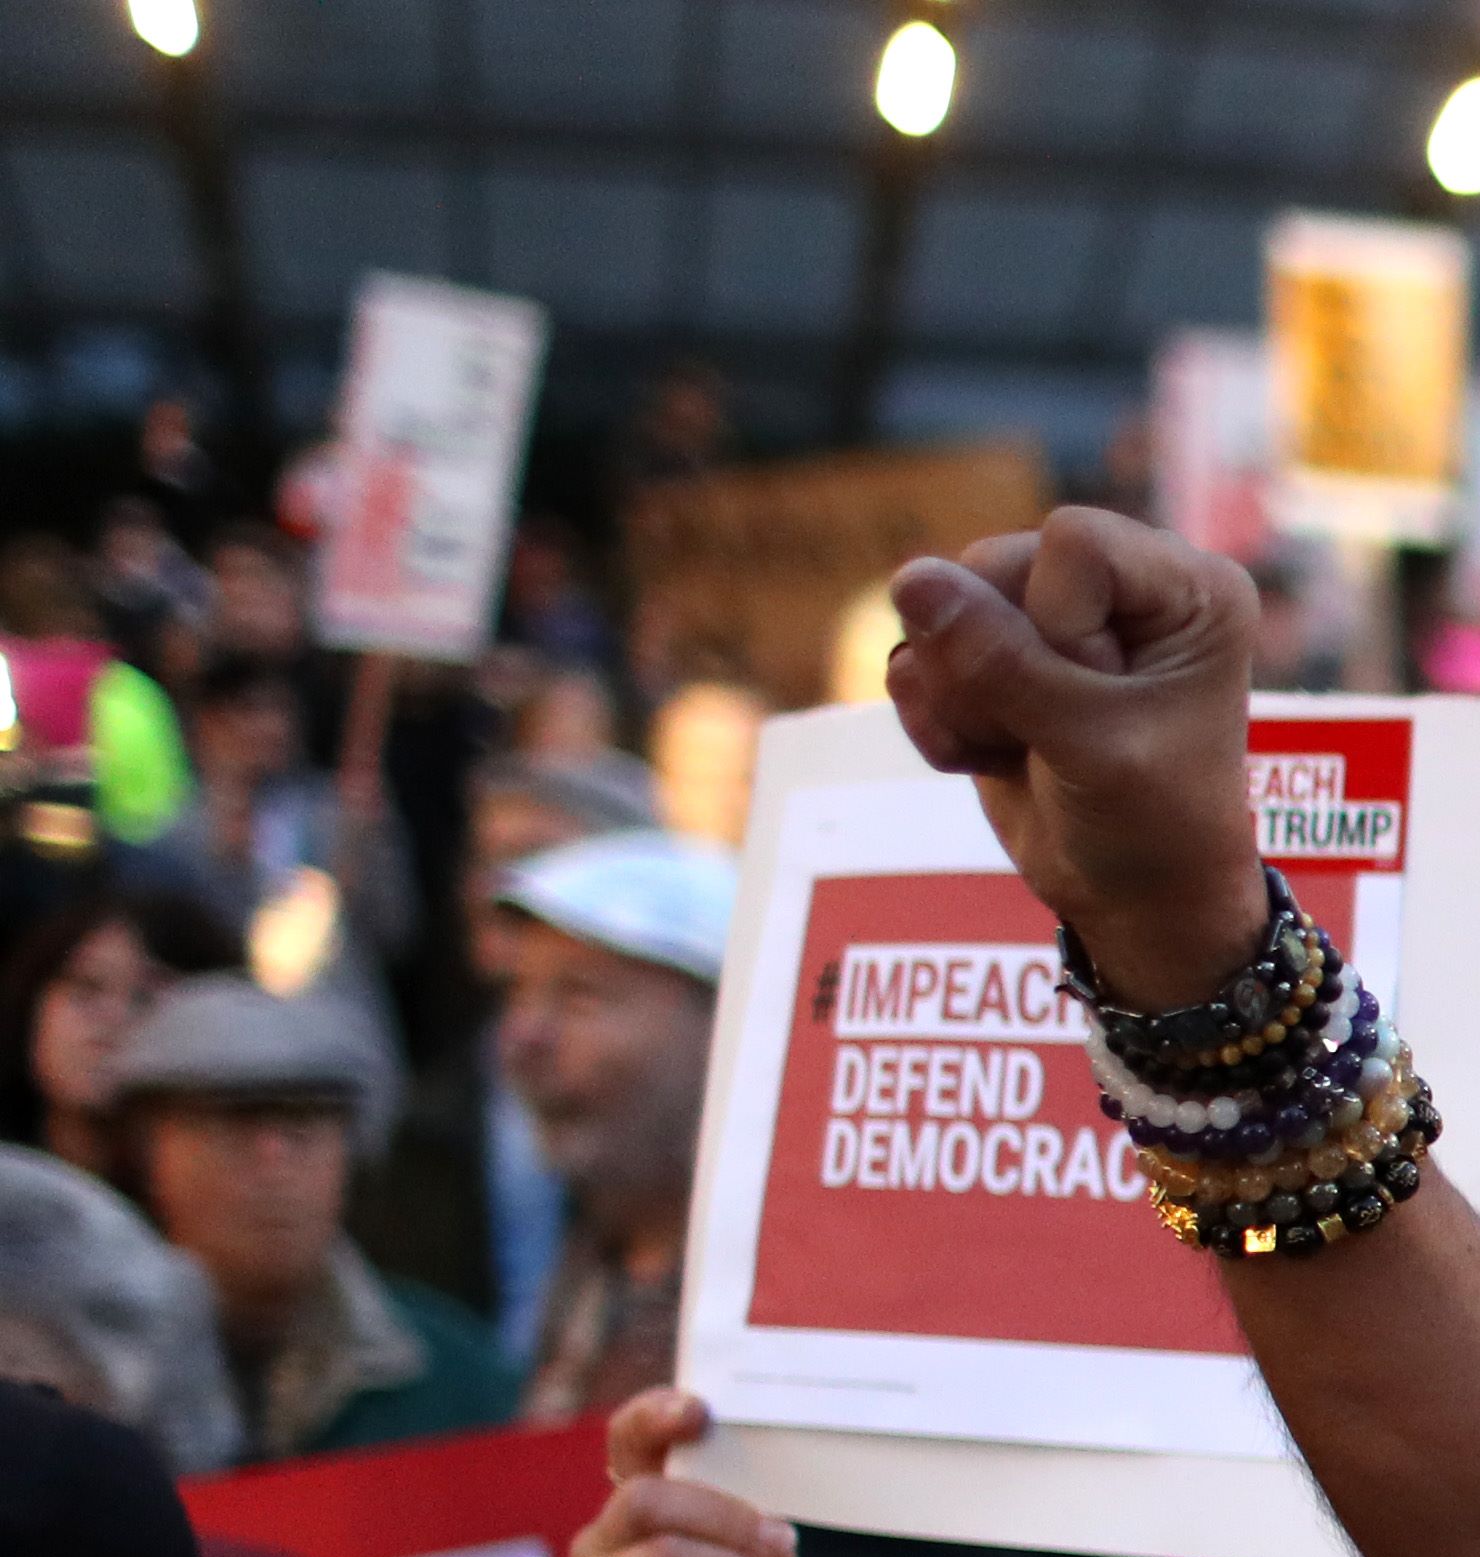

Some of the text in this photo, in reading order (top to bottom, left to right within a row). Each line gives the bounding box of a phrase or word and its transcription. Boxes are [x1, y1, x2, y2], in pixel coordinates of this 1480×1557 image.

[1264, 808, 1392, 848] TRUMP
[831, 1044, 1045, 1121] DEFEND
[820, 1117, 1147, 1201] DEMOCRAC
